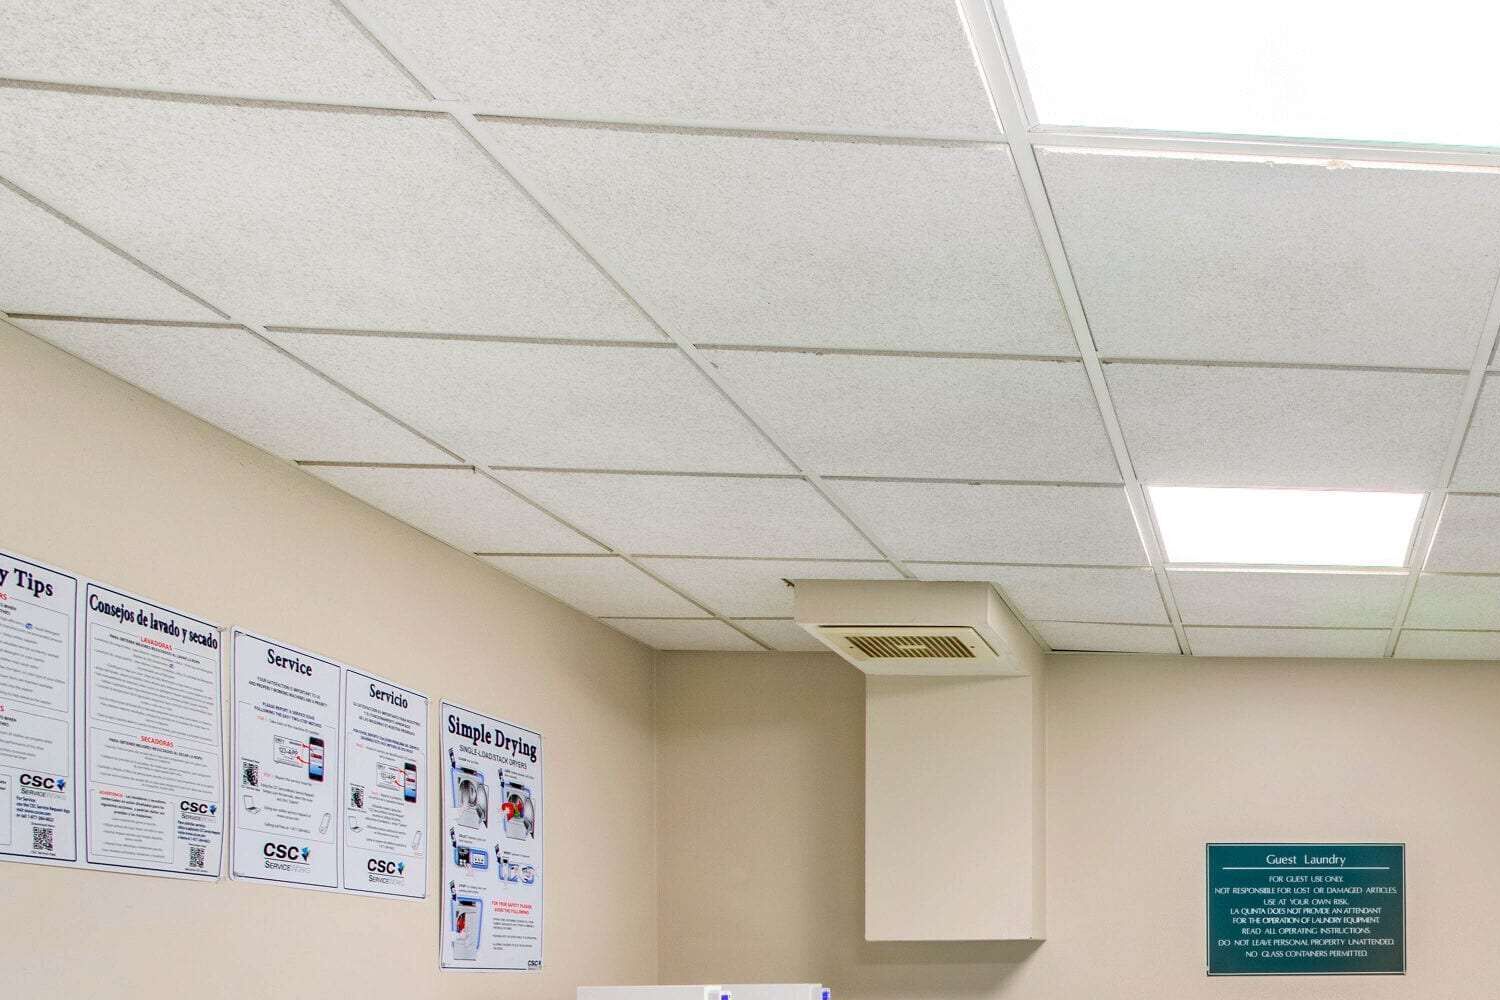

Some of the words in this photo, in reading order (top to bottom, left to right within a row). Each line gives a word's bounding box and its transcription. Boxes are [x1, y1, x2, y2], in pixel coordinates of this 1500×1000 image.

[14, 568, 53, 598] Tips
[90, 594, 134, 623] Consejos
[137, 609, 148, 627] de
[150, 613, 180, 637] lavado
[182, 628, 187, 643] y
[189, 630, 217, 649] secado
[267, 648, 312, 676] Service
[369, 684, 408, 708] Servicio
[448, 714, 491, 747] Simple
[495, 729, 537, 763] Drying
[20, 774, 55, 789] CSC
[180, 800, 208, 814] CSC
[264, 843, 299, 861] CSC
[1266, 854, 1297, 865] Guest
[1304, 853, 1346, 868] Laundry
[367, 859, 396, 874] CSC
[1269, 875, 1283, 883] FOR
[1286, 875, 1308, 883] GUEST
[1311, 875, 1323, 883] USE
[1325, 875, 1344, 883] ONLY.
